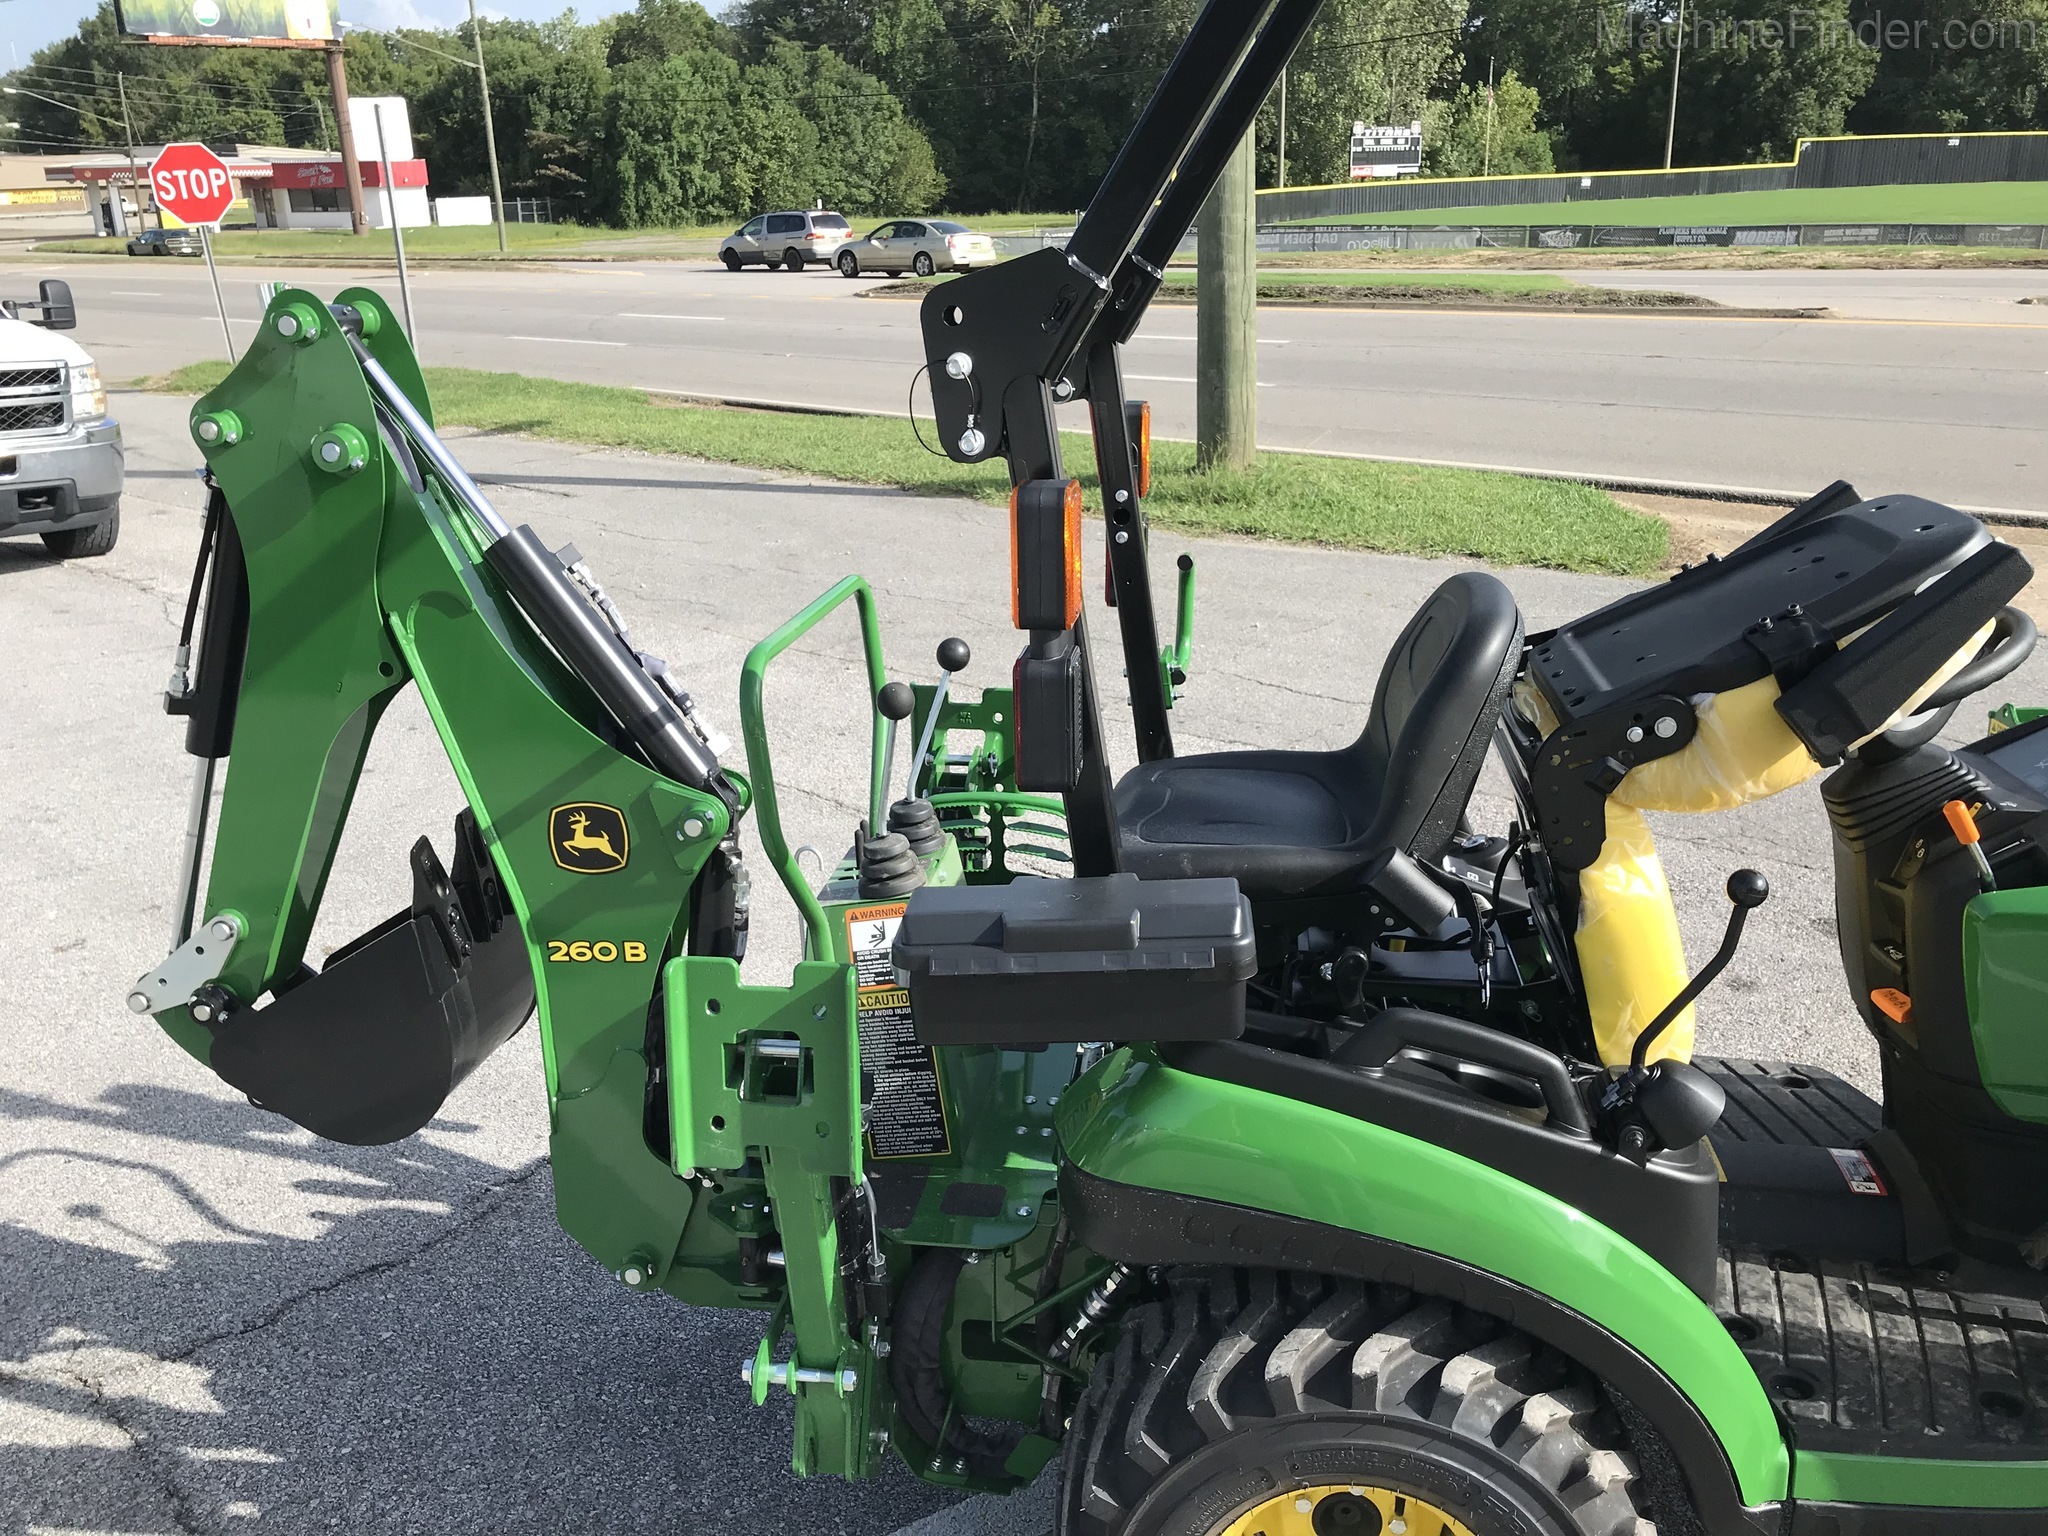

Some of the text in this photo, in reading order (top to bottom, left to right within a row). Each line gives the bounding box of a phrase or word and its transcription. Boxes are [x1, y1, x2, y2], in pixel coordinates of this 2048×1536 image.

[156, 168, 226, 201] STOP
[1733, 231, 1798, 245] MODERN
[860, 907, 904, 919] WARNING
[548, 940, 648, 963] 260 B
[866, 993, 908, 1007] CAUTIO
